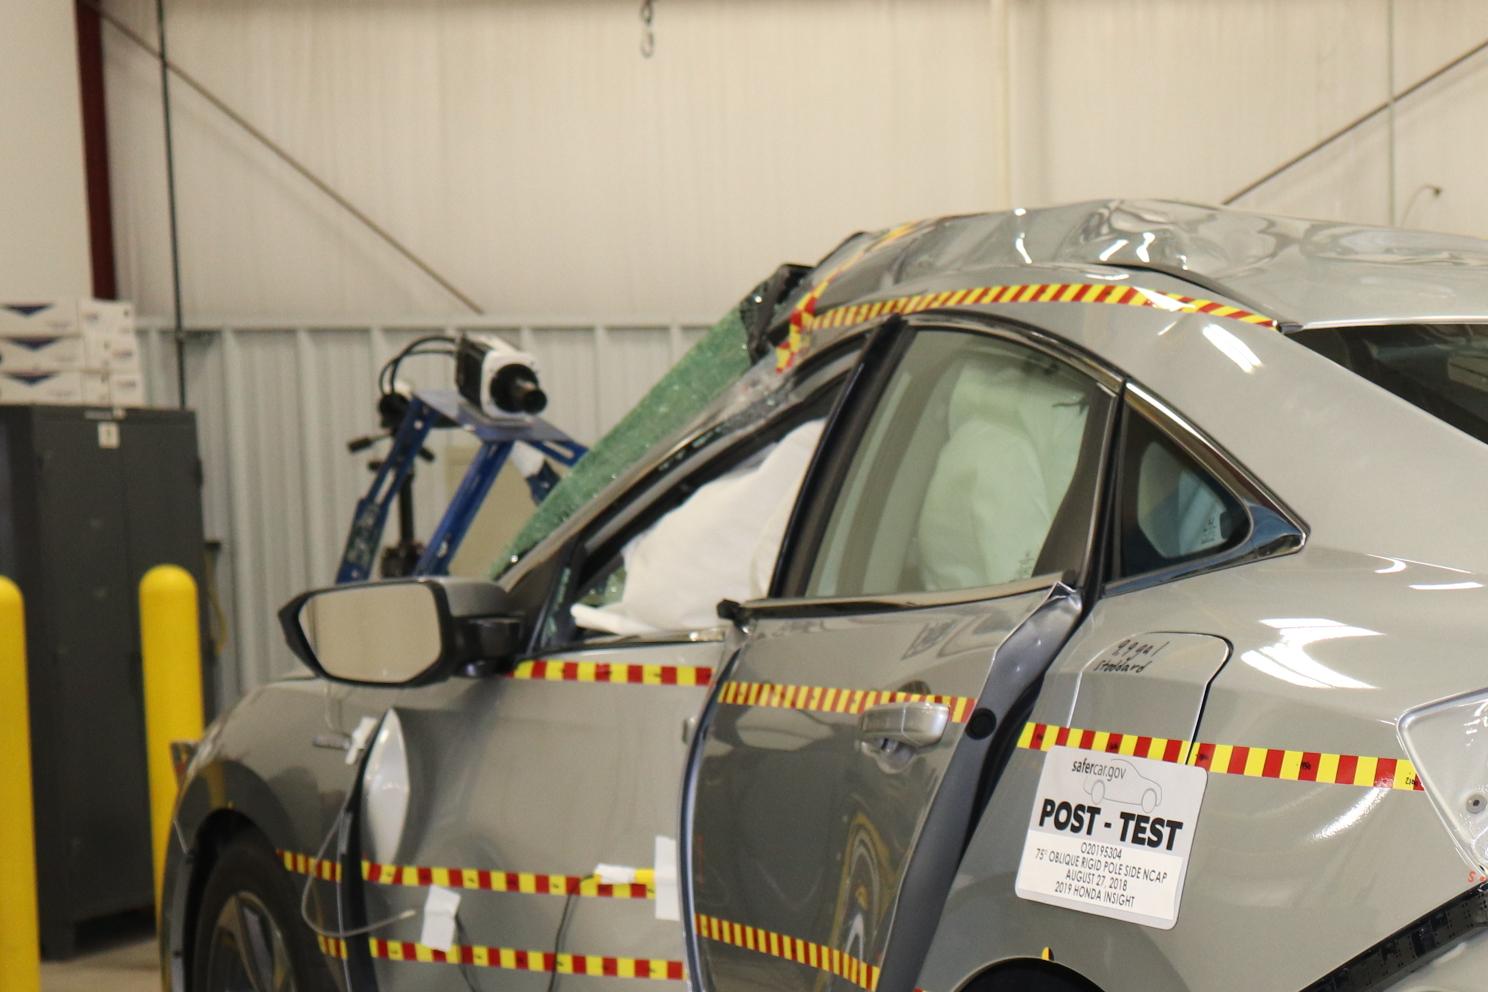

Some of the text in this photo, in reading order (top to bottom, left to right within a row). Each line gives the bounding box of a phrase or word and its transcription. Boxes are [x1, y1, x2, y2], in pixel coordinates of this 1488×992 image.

[1071, 758, 1127, 782] safercar.gov
[1038, 798, 1102, 836] POST
[1119, 811, 1184, 851] TEST
[1049, 850, 1080, 867] OBLIQUE
[1080, 856, 1102, 871] RIGID
[1103, 861, 1123, 876] POLE
[1124, 865, 1142, 879] SIDE
[1142, 869, 1168, 884] NCAP
[1065, 869, 1095, 885] AUGUST
[1109, 876, 1128, 892] 2018
[1054, 881, 1136, 908] 2019 HONDA INSIGHT
